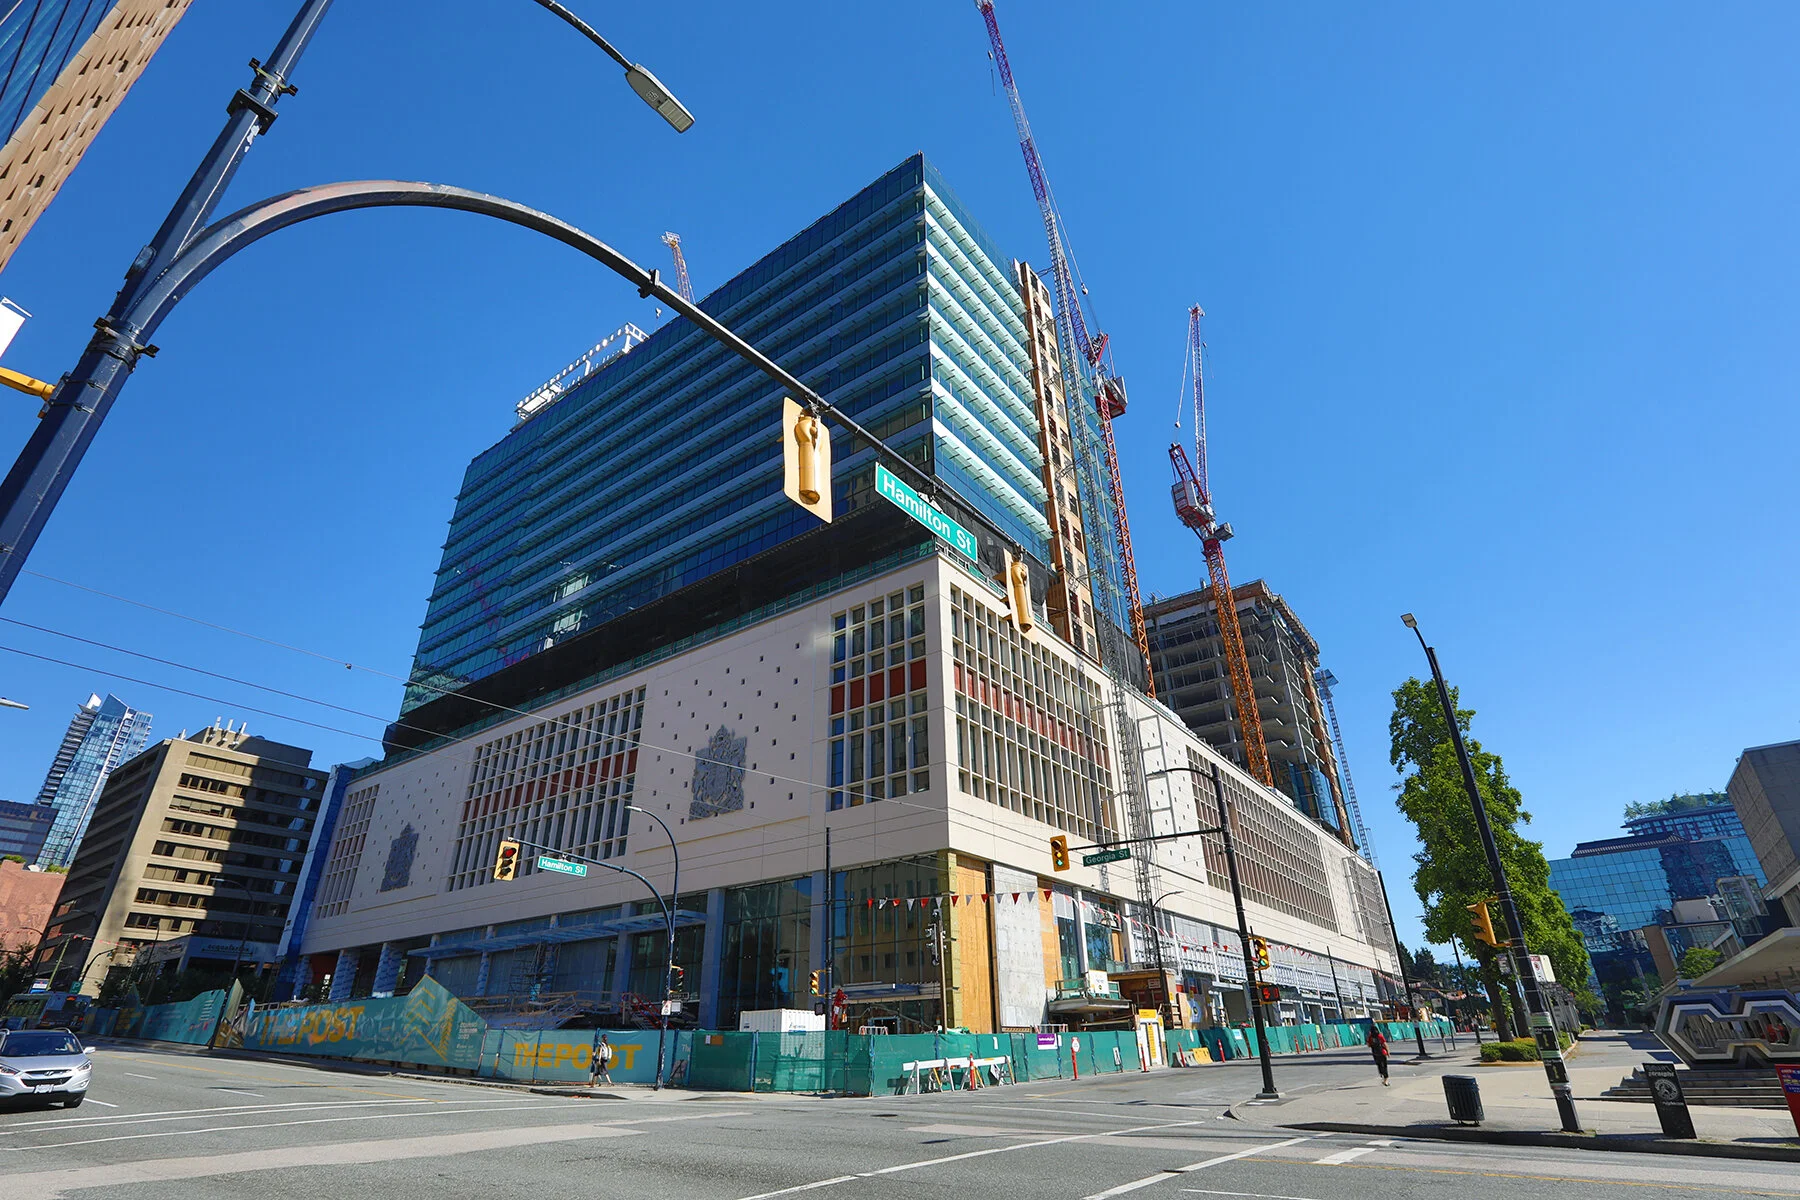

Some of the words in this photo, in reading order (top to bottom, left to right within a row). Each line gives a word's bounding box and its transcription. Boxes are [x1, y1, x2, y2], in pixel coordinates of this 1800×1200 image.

[883, 474, 951, 539] Hamilton
[956, 529, 972, 554] St
[1085, 852, 1116, 864] Georgia
[1119, 850, 1128, 858] St
[541, 859, 573, 872] Hamilton
[575, 865, 584, 874] St
